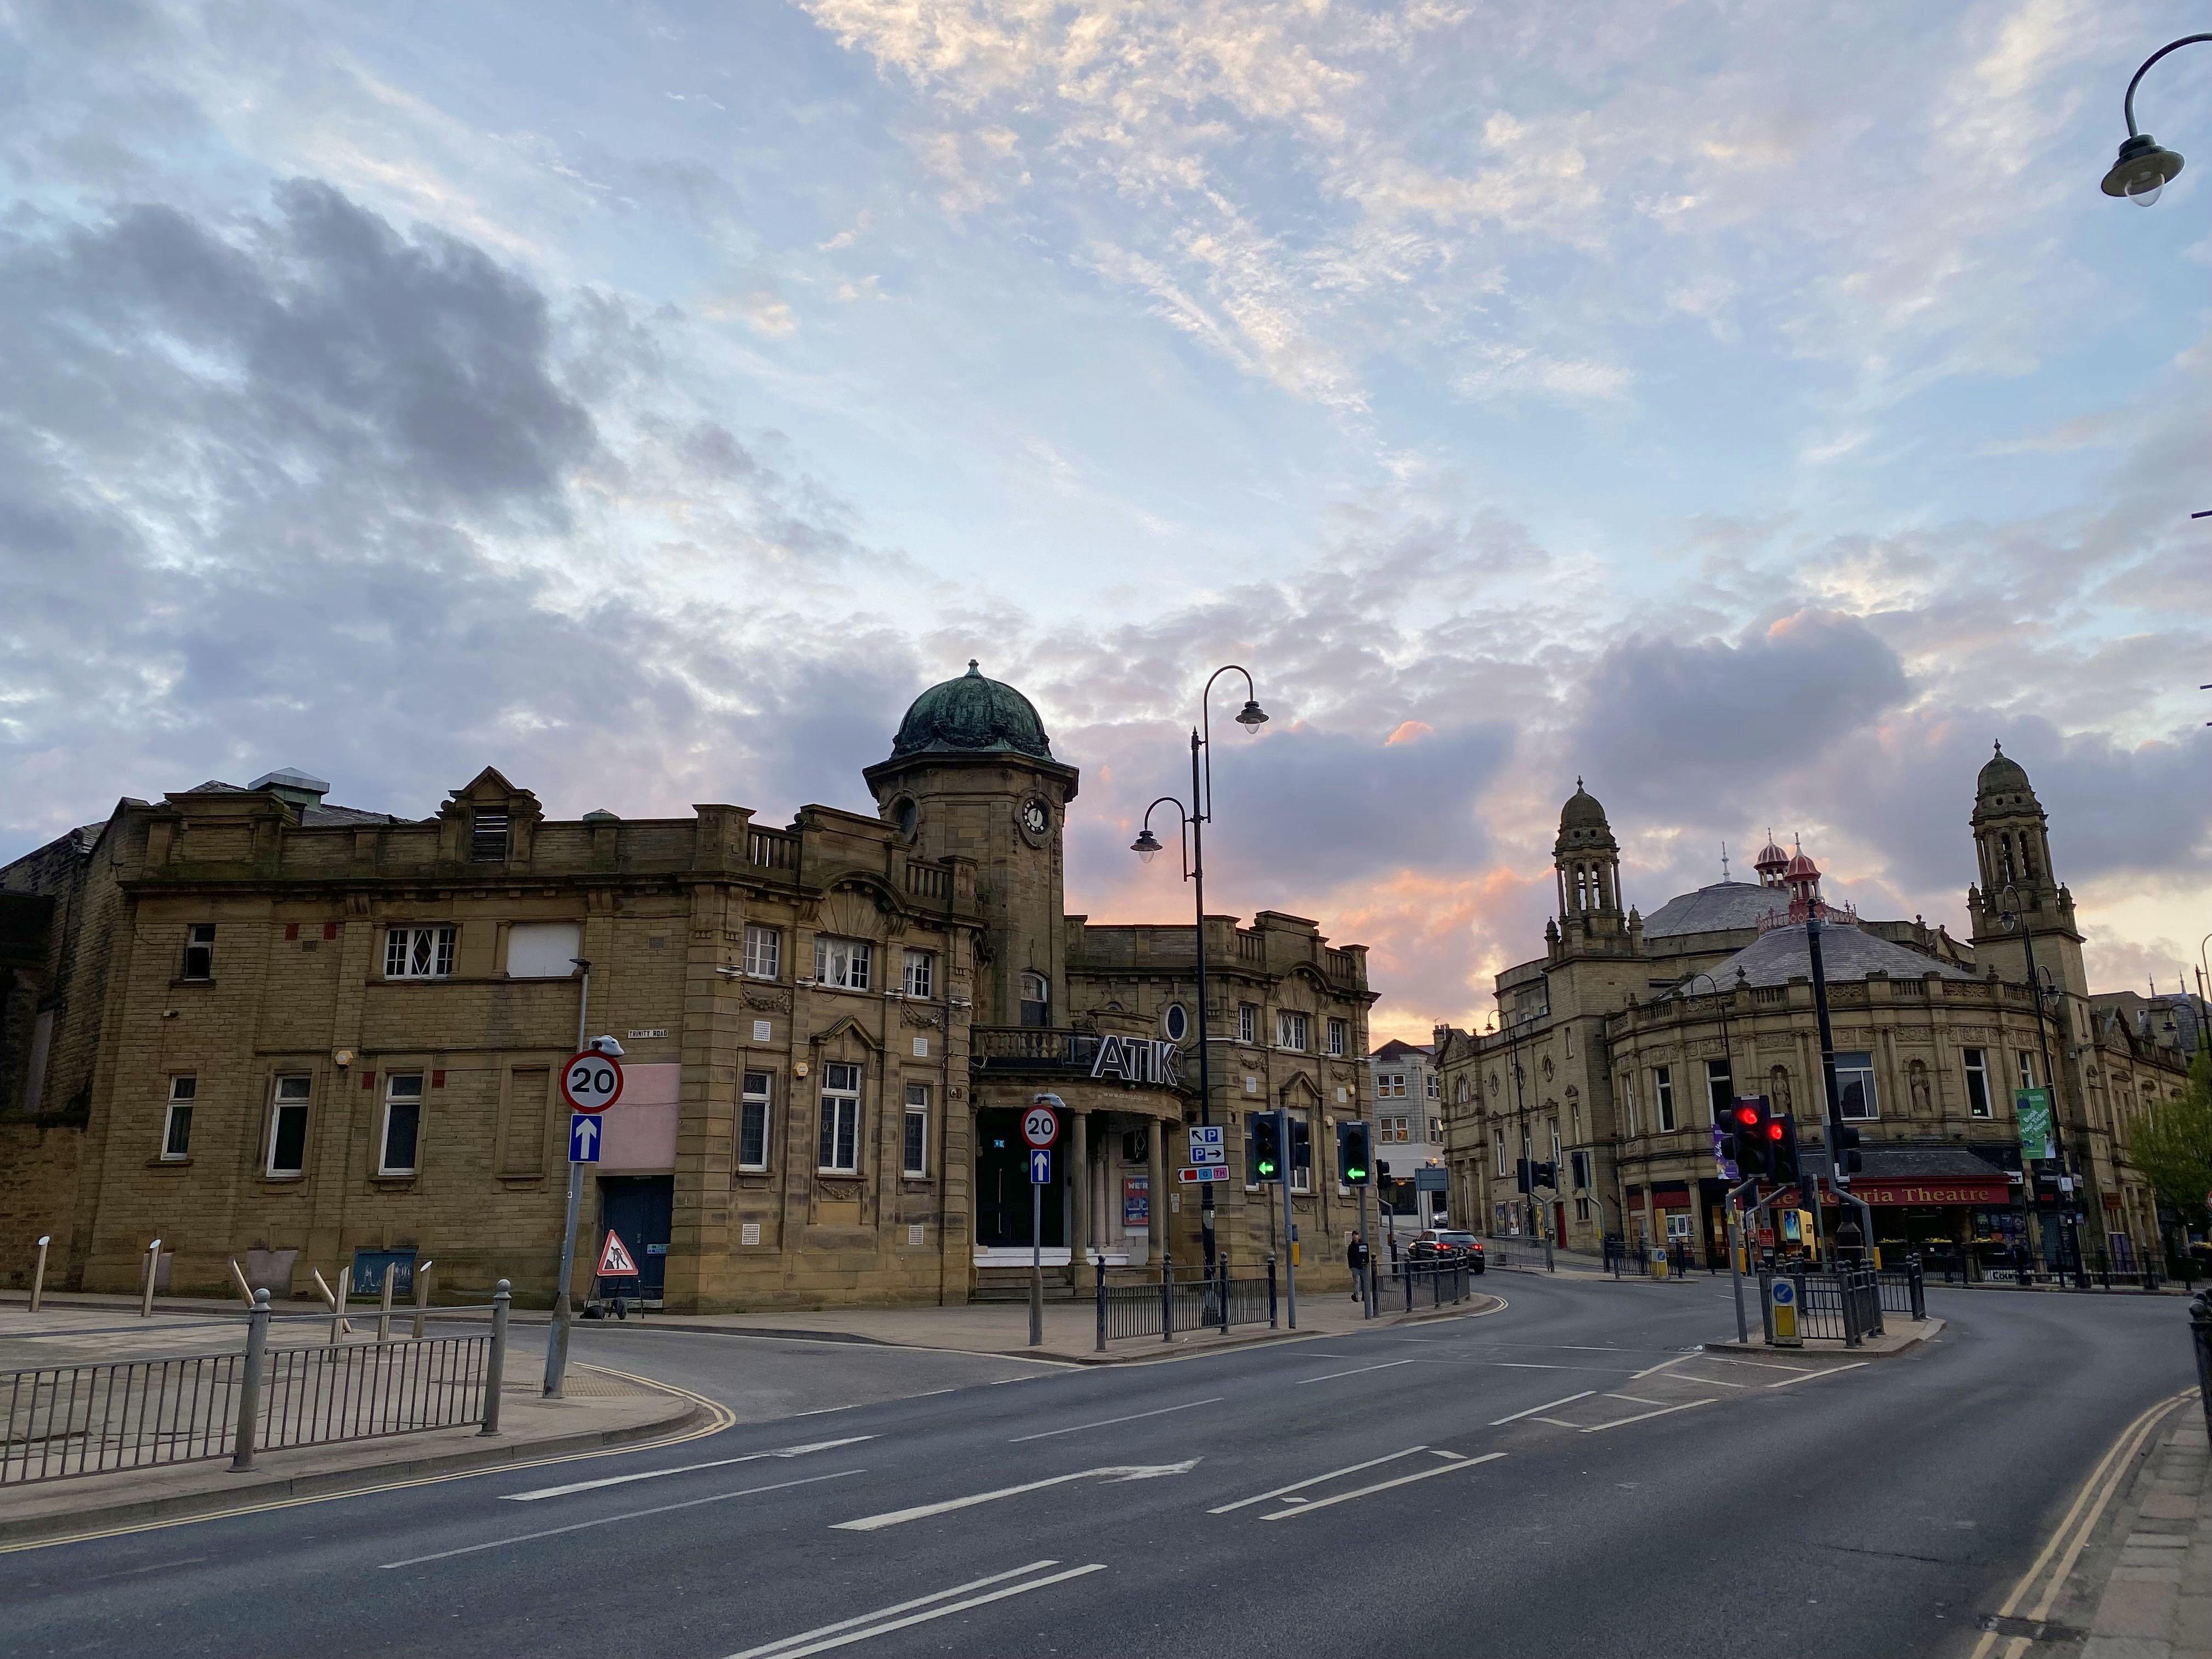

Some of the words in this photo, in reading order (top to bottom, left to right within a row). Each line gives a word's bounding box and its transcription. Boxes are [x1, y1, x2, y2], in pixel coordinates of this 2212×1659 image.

[1090, 1035, 1178, 1086] ATIK
[572, 1067, 614, 1094] 20
[2023, 1109, 2039, 1122] Book
[1028, 1117, 1053, 1135] 20
[2021, 1122, 2034, 1134] Your
[2032, 1119, 2047, 1132] Now
[1208, 1130, 1216, 1141] P
[1195, 1149, 1204, 1160] P
[1901, 1187, 1990, 1203] Theatre
